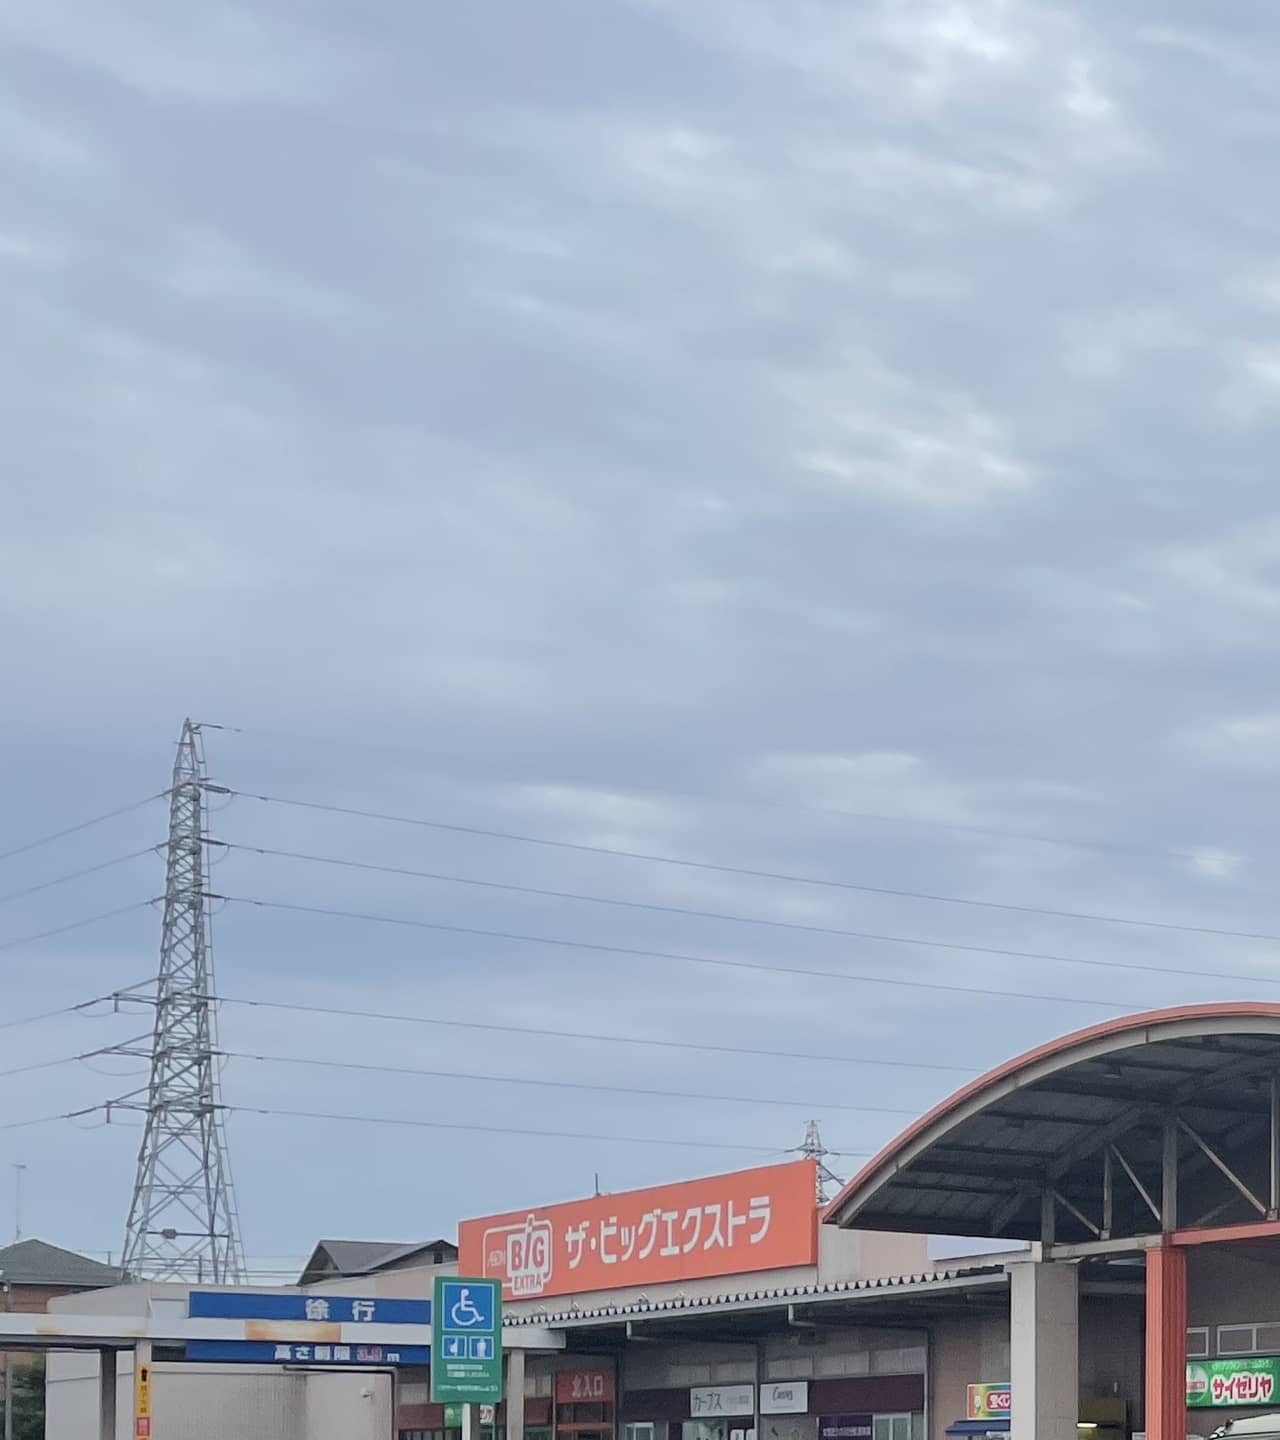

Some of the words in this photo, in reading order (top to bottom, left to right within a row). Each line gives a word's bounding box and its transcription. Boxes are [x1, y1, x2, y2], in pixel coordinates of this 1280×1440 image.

[565, 1196, 771, 1269] ザ・ビッグエクストラ
[514, 1273, 542, 1291] EXTRA
[572, 1376, 603, 1398] 北入口
[1212, 1374, 1272, 1401] サイゼリヤ
